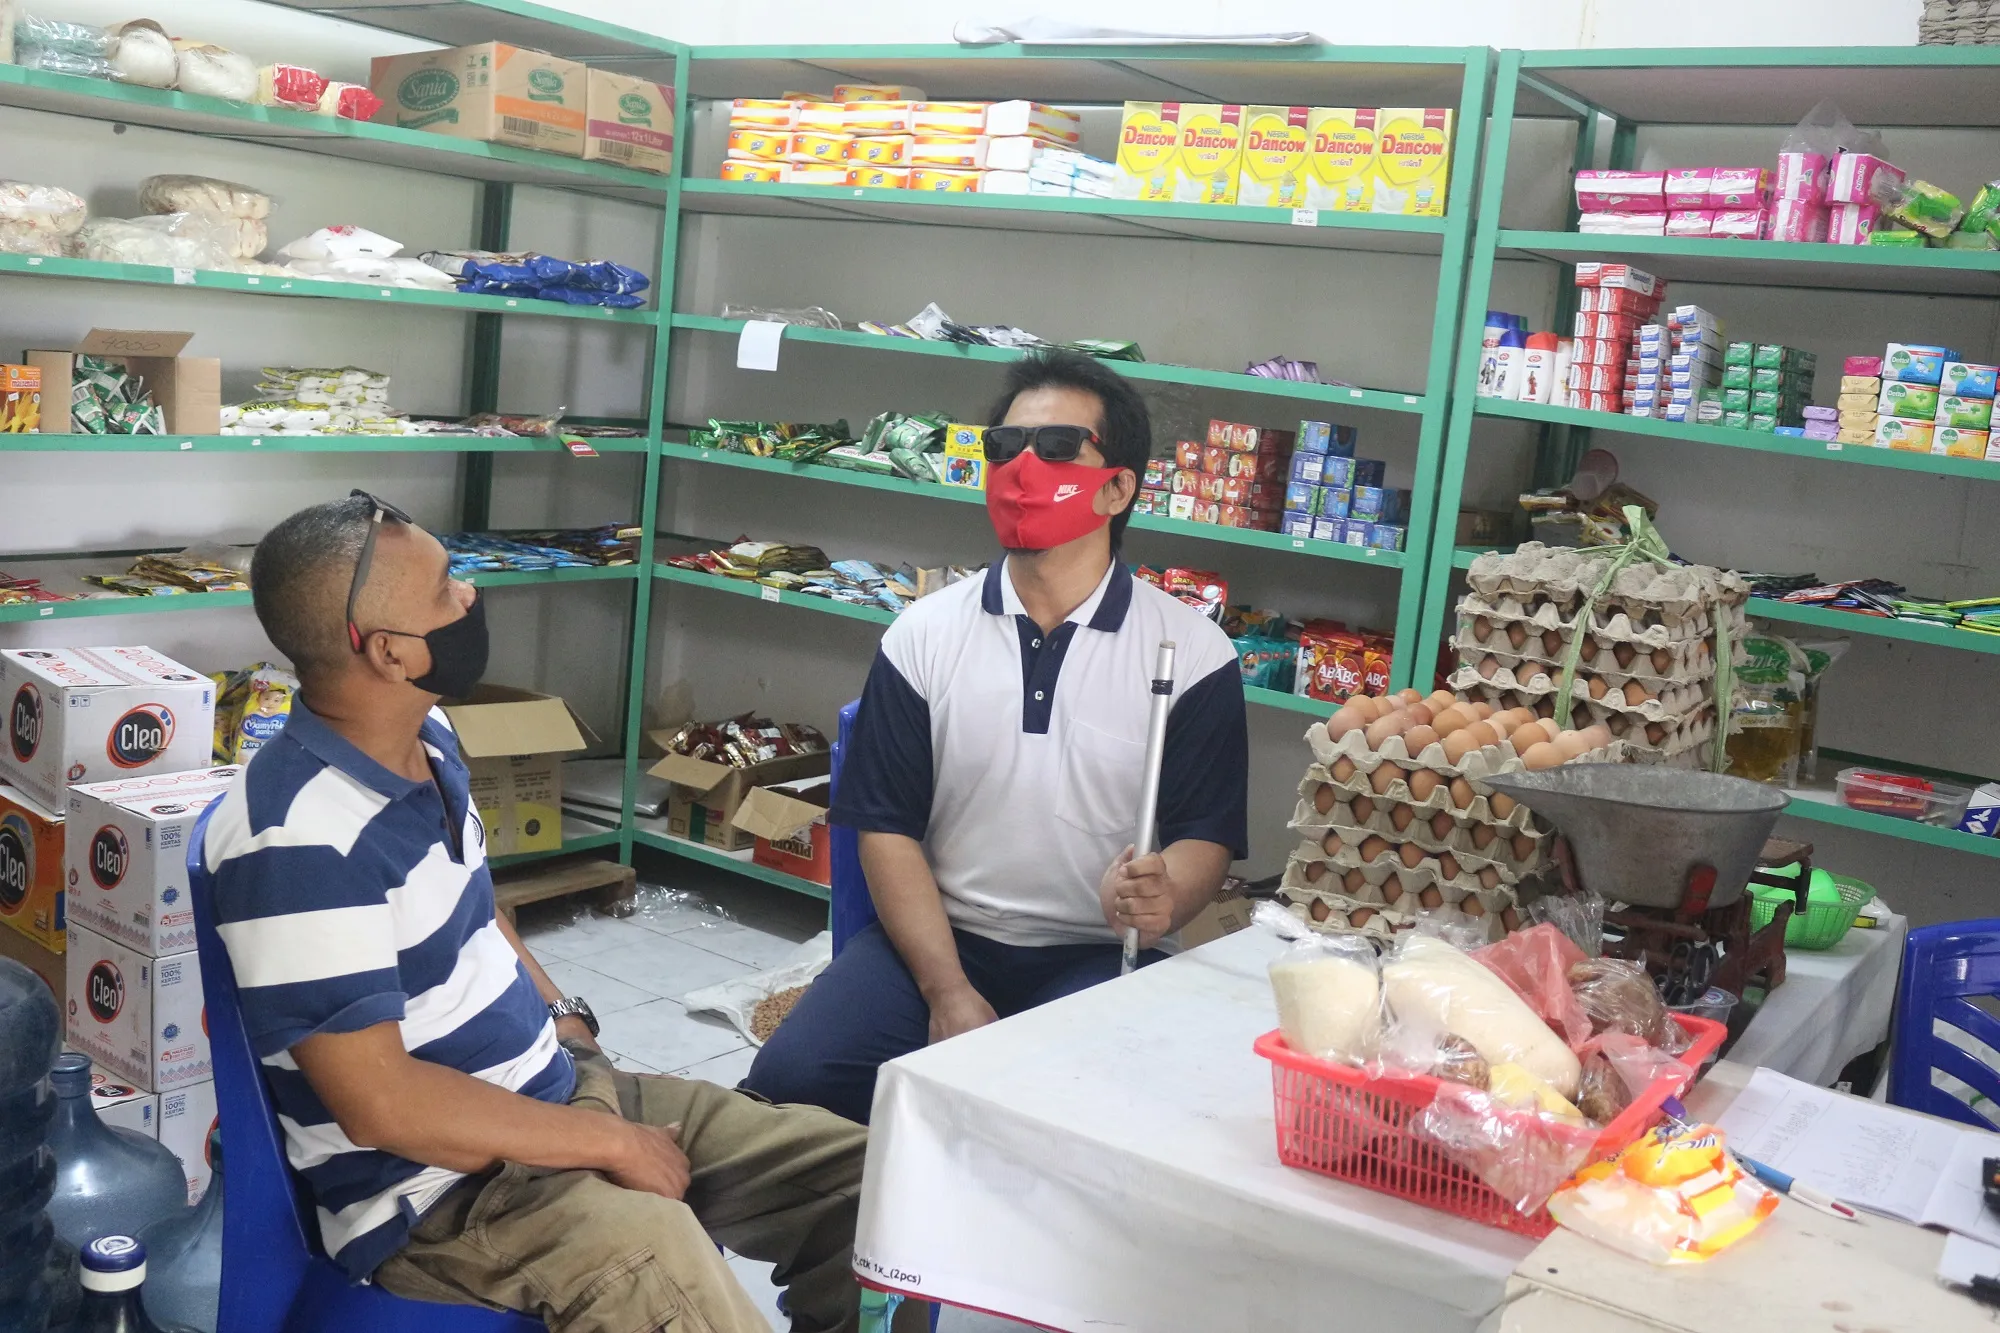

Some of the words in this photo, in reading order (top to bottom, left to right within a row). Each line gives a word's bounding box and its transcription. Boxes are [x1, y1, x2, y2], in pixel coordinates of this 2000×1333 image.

[534, 70, 559, 88] Sania
[408, 77, 448, 102] Sania
[623, 98, 648, 112] Sania
[1124, 125, 1177, 146] Dancow
[1183, 128, 1239, 149] Dancow
[1249, 130, 1306, 153] Dancow
[1314, 133, 1374, 155] Dancow
[1381, 134, 1444, 156] Dancow
[1891, 356, 1910, 365] Dettol
[1950, 370, 1968, 378] Dettol
[1887, 390, 1906, 398] Dettol
[1941, 434, 1958, 442] Dettol
[1057, 484, 1079, 495] NIKE
[1317, 665, 1336, 679] AB
[1333, 668, 1360, 685] ABC
[1365, 672, 1388, 688] ABC
[16, 702, 36, 745] Cleo
[121, 724, 162, 751] Cleo
[160, 832, 181, 841] 100%
[96, 841, 121, 875] Cleo
[161, 969, 182, 978] 100%
[161, 976, 182, 984] KERTAS
[93, 974, 117, 1011] Cleo
[164, 1100, 186, 1110] 100%
[164, 1107, 186, 1116] KERTAS
